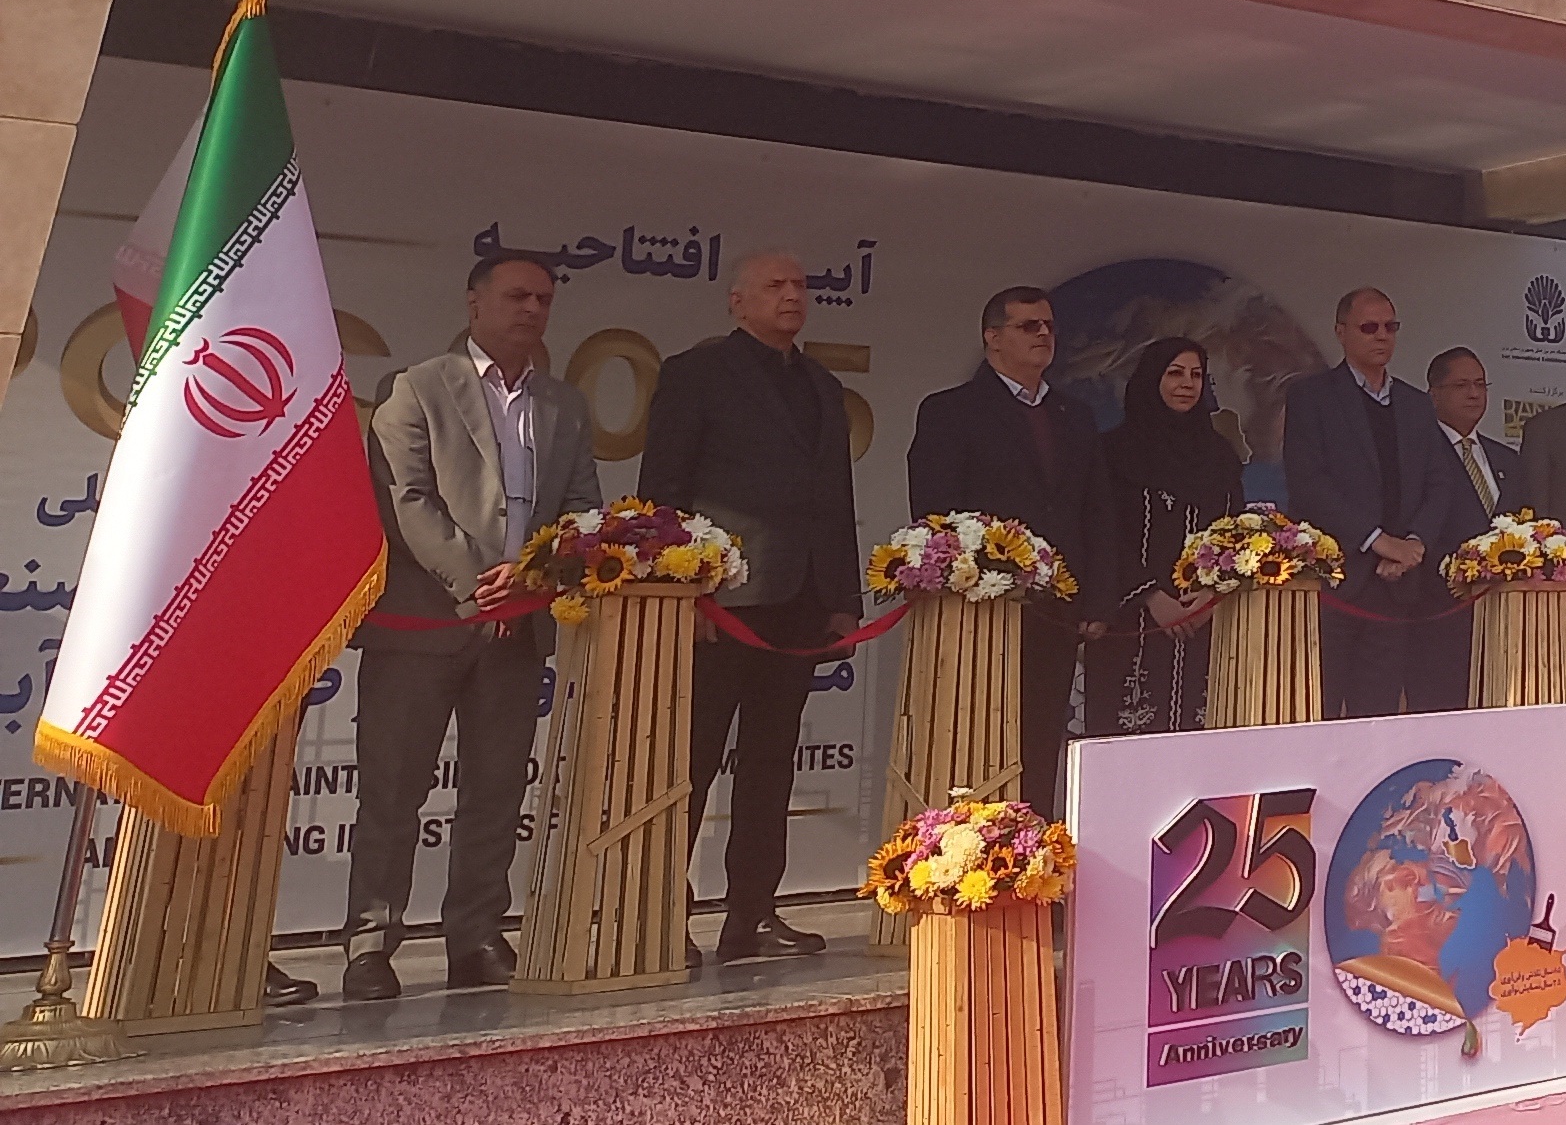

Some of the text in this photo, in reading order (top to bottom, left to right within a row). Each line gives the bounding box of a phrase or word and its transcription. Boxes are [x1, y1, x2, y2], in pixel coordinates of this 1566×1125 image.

[1150, 787, 1317, 950] 25
[1161, 951, 1303, 1013] YEARS
[1158, 1026, 1304, 1066] Anniversary
